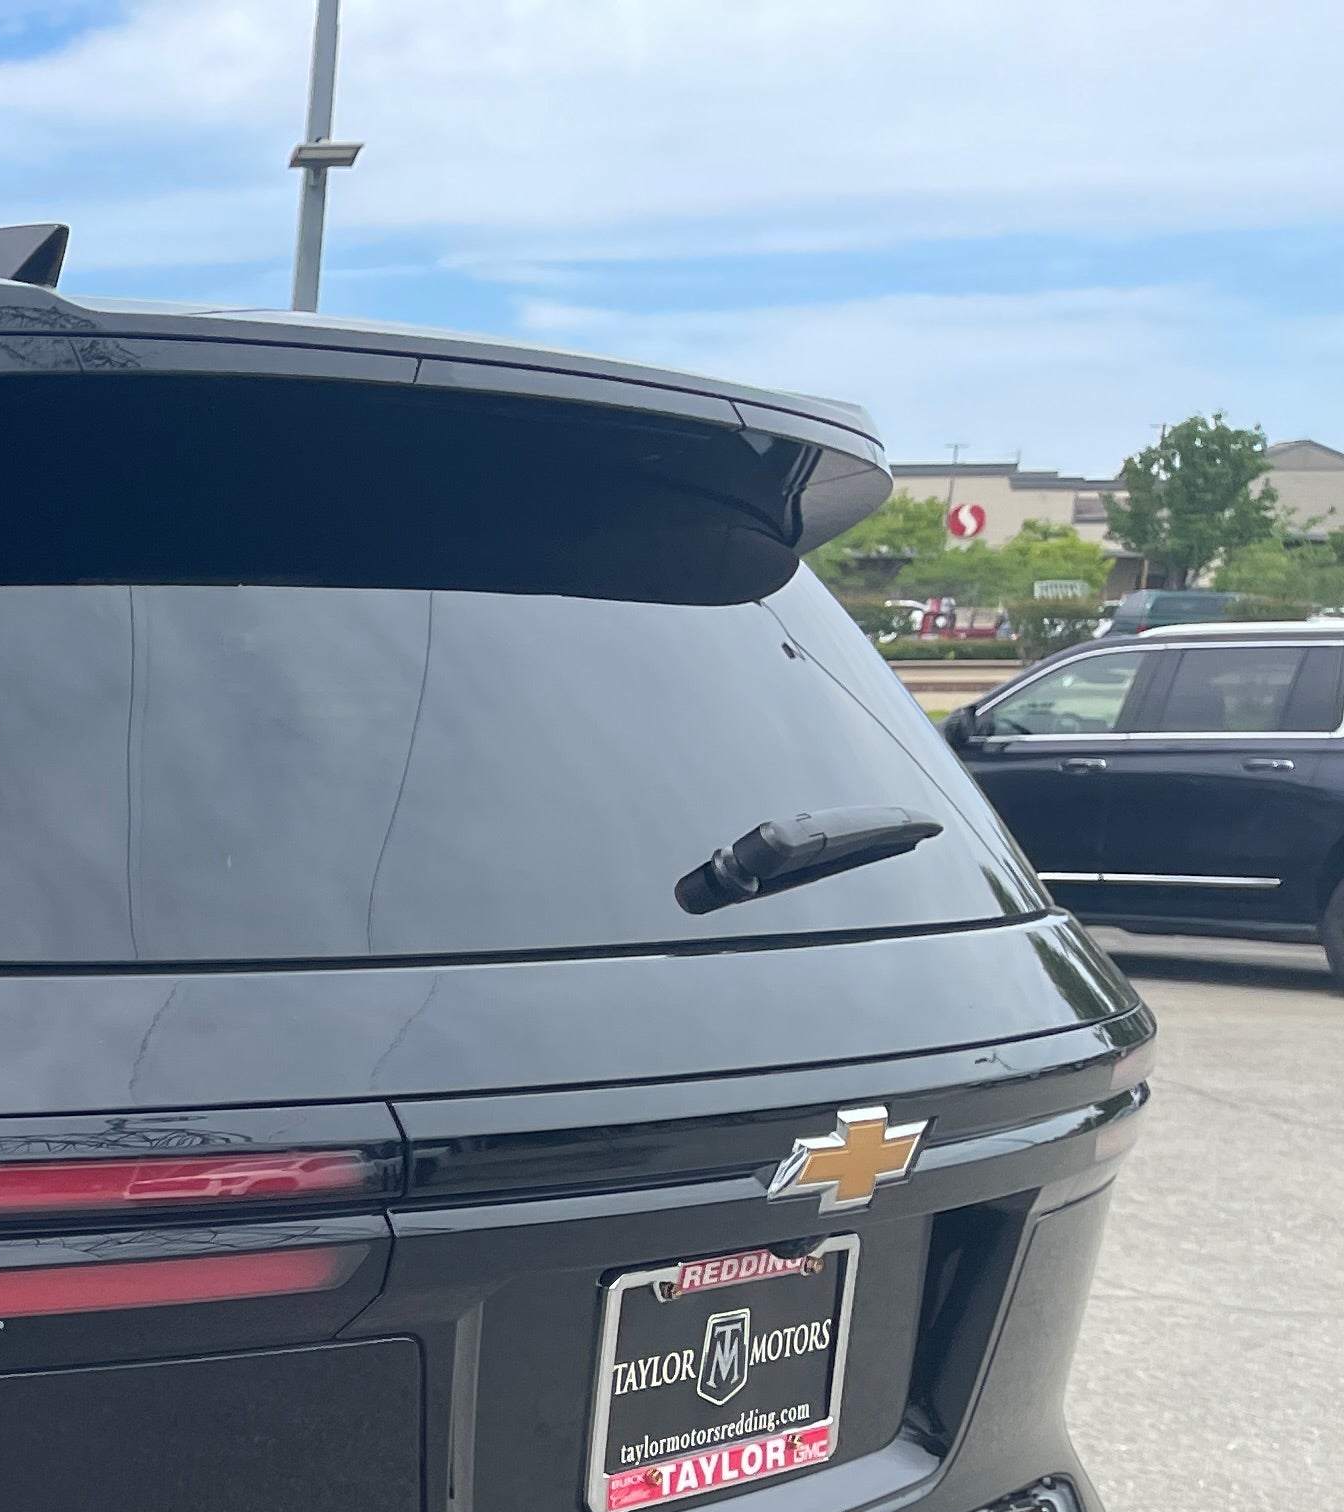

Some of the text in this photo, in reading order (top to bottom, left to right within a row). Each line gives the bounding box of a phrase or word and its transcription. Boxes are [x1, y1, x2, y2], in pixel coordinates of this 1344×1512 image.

[613, 1349, 697, 1395] TAYLOR
[749, 1318, 832, 1366] MOTORS
[619, 1401, 811, 1465] taylormotorsredding.com
[793, 1440, 827, 1463] GMC
[658, 1438, 786, 1496] TAYLOR
